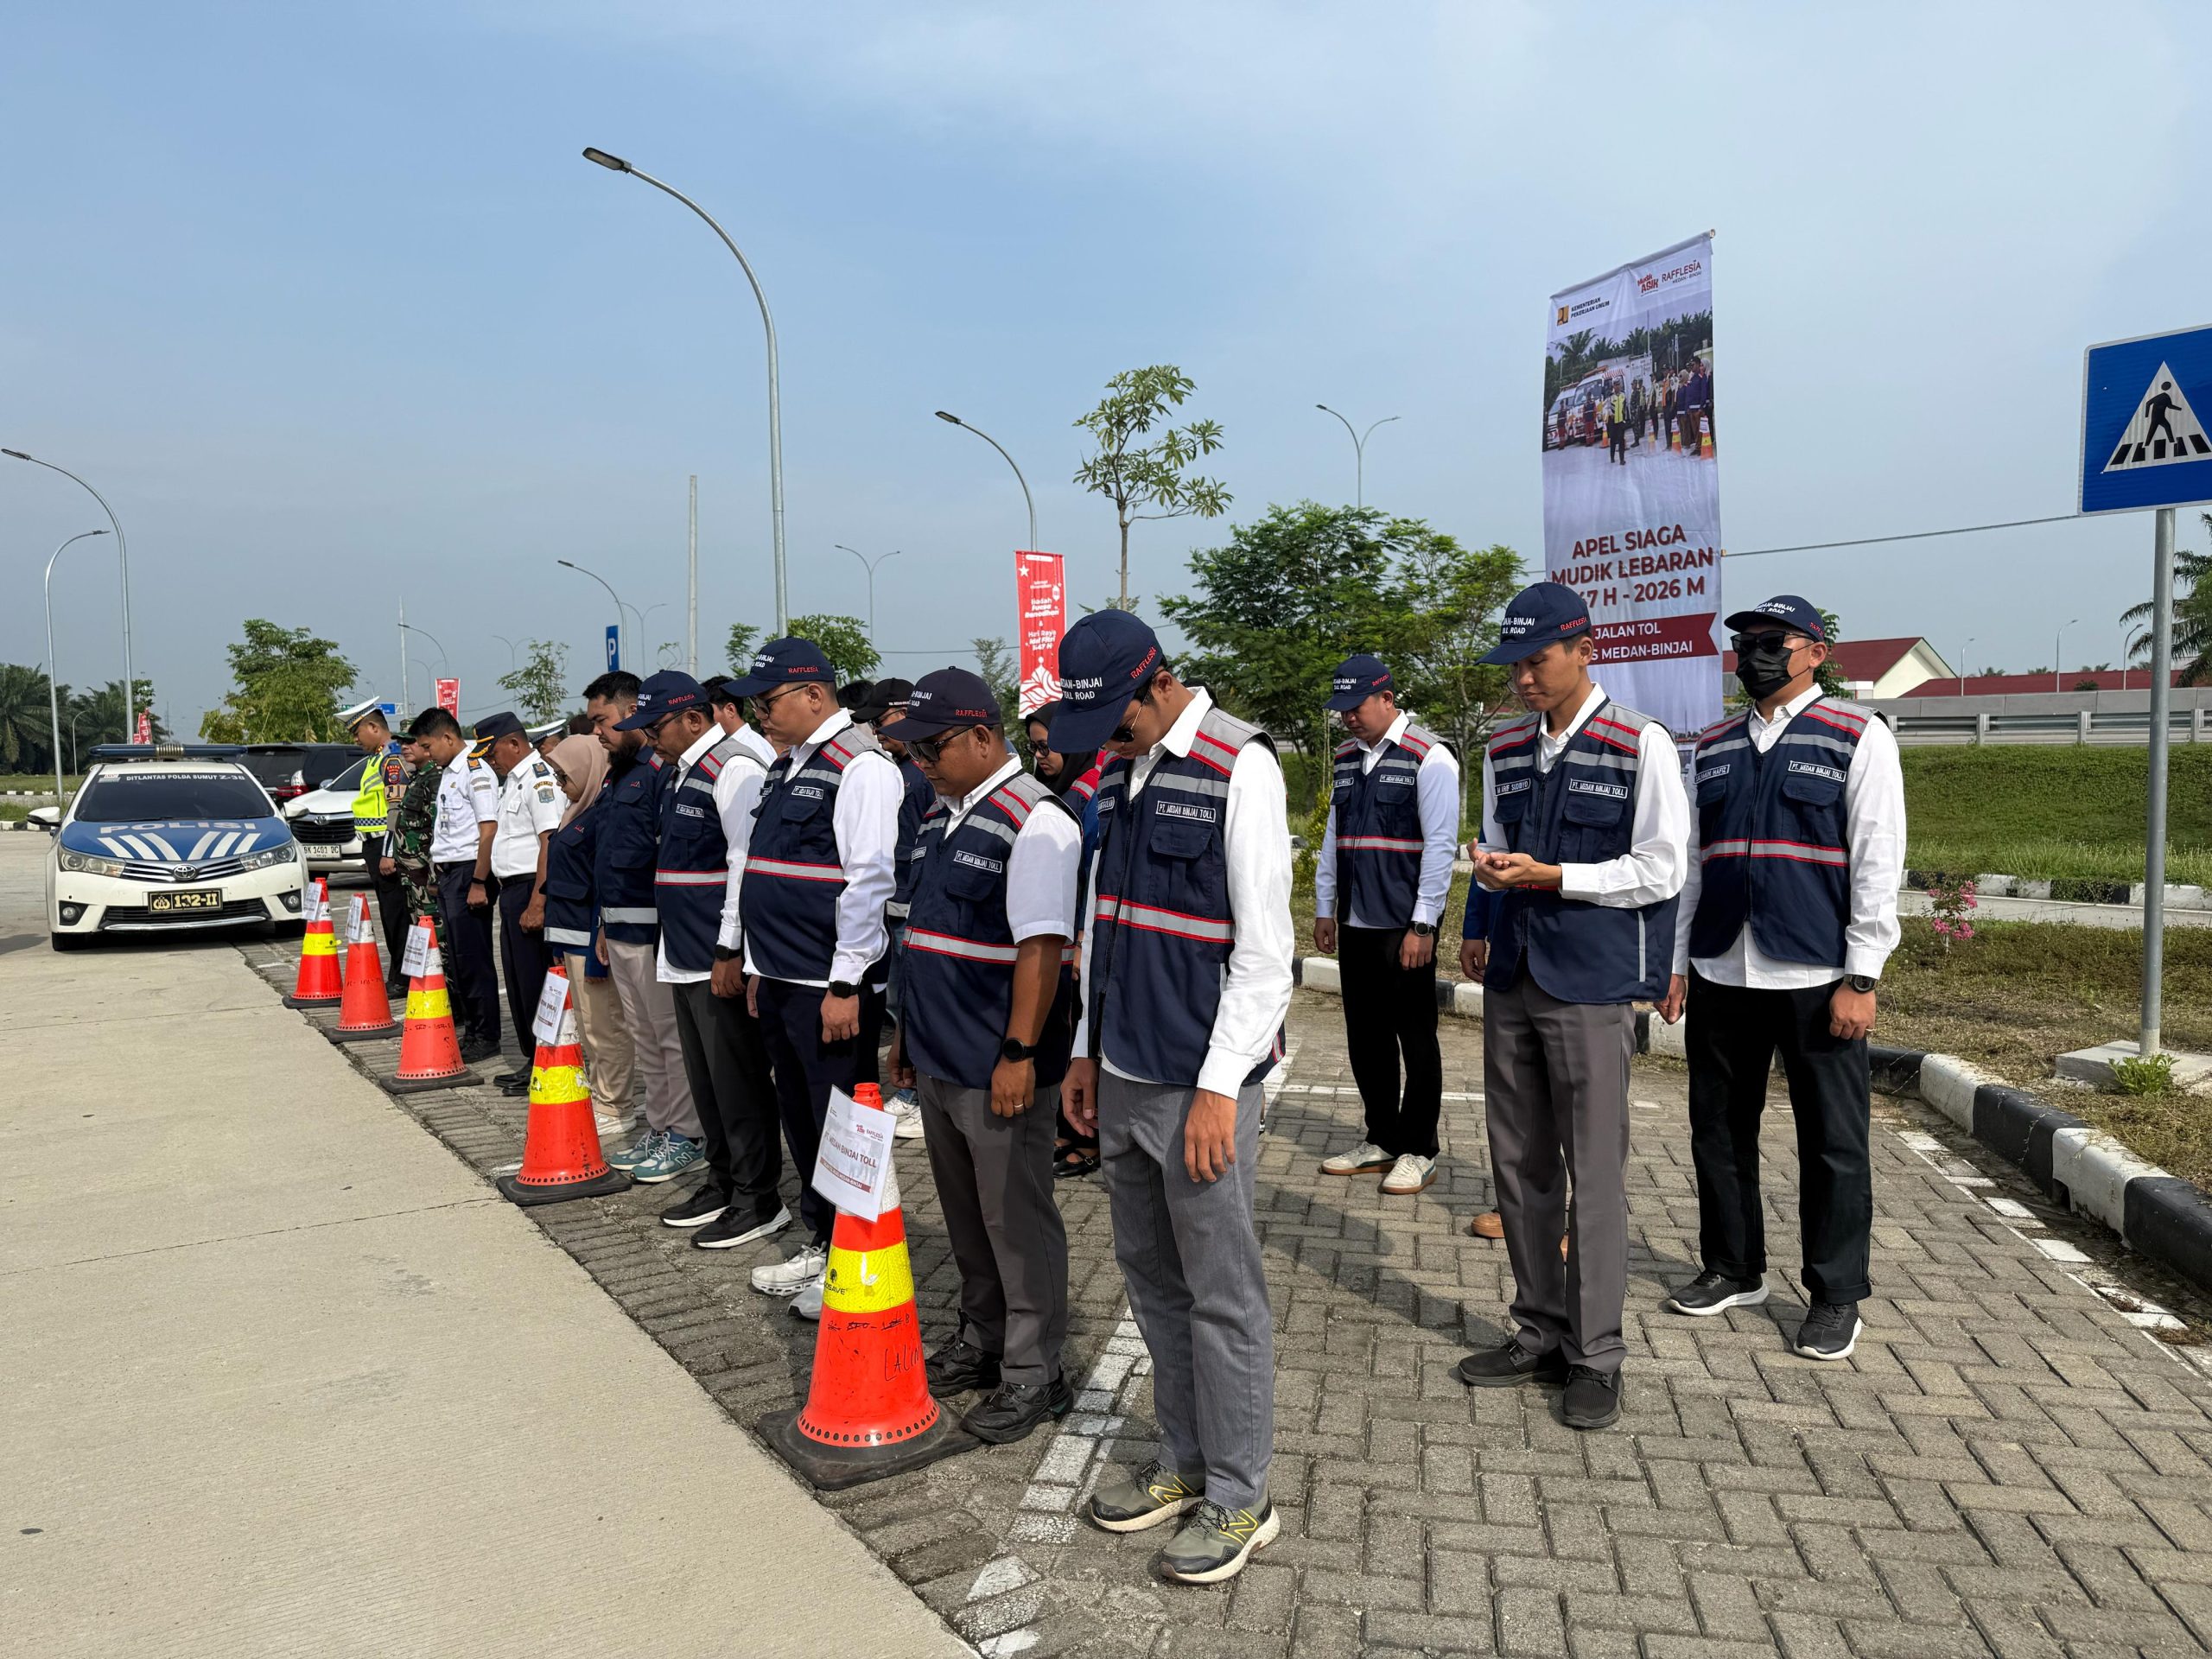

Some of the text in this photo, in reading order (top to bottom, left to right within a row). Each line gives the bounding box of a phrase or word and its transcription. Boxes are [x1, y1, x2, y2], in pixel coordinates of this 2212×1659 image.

[1641, 278, 1659, 294] ASIK
[1571, 297, 1601, 312] KEMENTERIAN
[1571, 301, 1609, 318] PEKERJAAN UMUM
[1572, 524, 1687, 560] APEL SIAGA
[1552, 546, 1714, 586] MUDIK LEBARAN
[1603, 587, 1618, 606] H
[1633, 579, 1681, 602] 2026
[1687, 575, 1705, 596] M
[1510, 626, 1526, 634] ROAD
[1594, 622, 1661, 639] JALAN TOL
[608, 638, 617, 665] P
[1601, 640, 1693, 660] MEDAN-BINJAI
[1075, 691, 1096, 700] ROAD
[1800, 764, 1815, 772] MEDAN
[1832, 770, 1843, 779] TOLL
[1595, 785, 1611, 794] BINJAI
[1612, 787, 1624, 796] TOLL
[1166, 804, 1181, 814] MEDAN
[1183, 807, 1198, 817] BINJAI
[1200, 810, 1212, 819] TOLL
[100, 822, 256, 834] POLISI
[841, 1144, 859, 1160] BINJAI
[860, 1154, 876, 1168] TOLL
